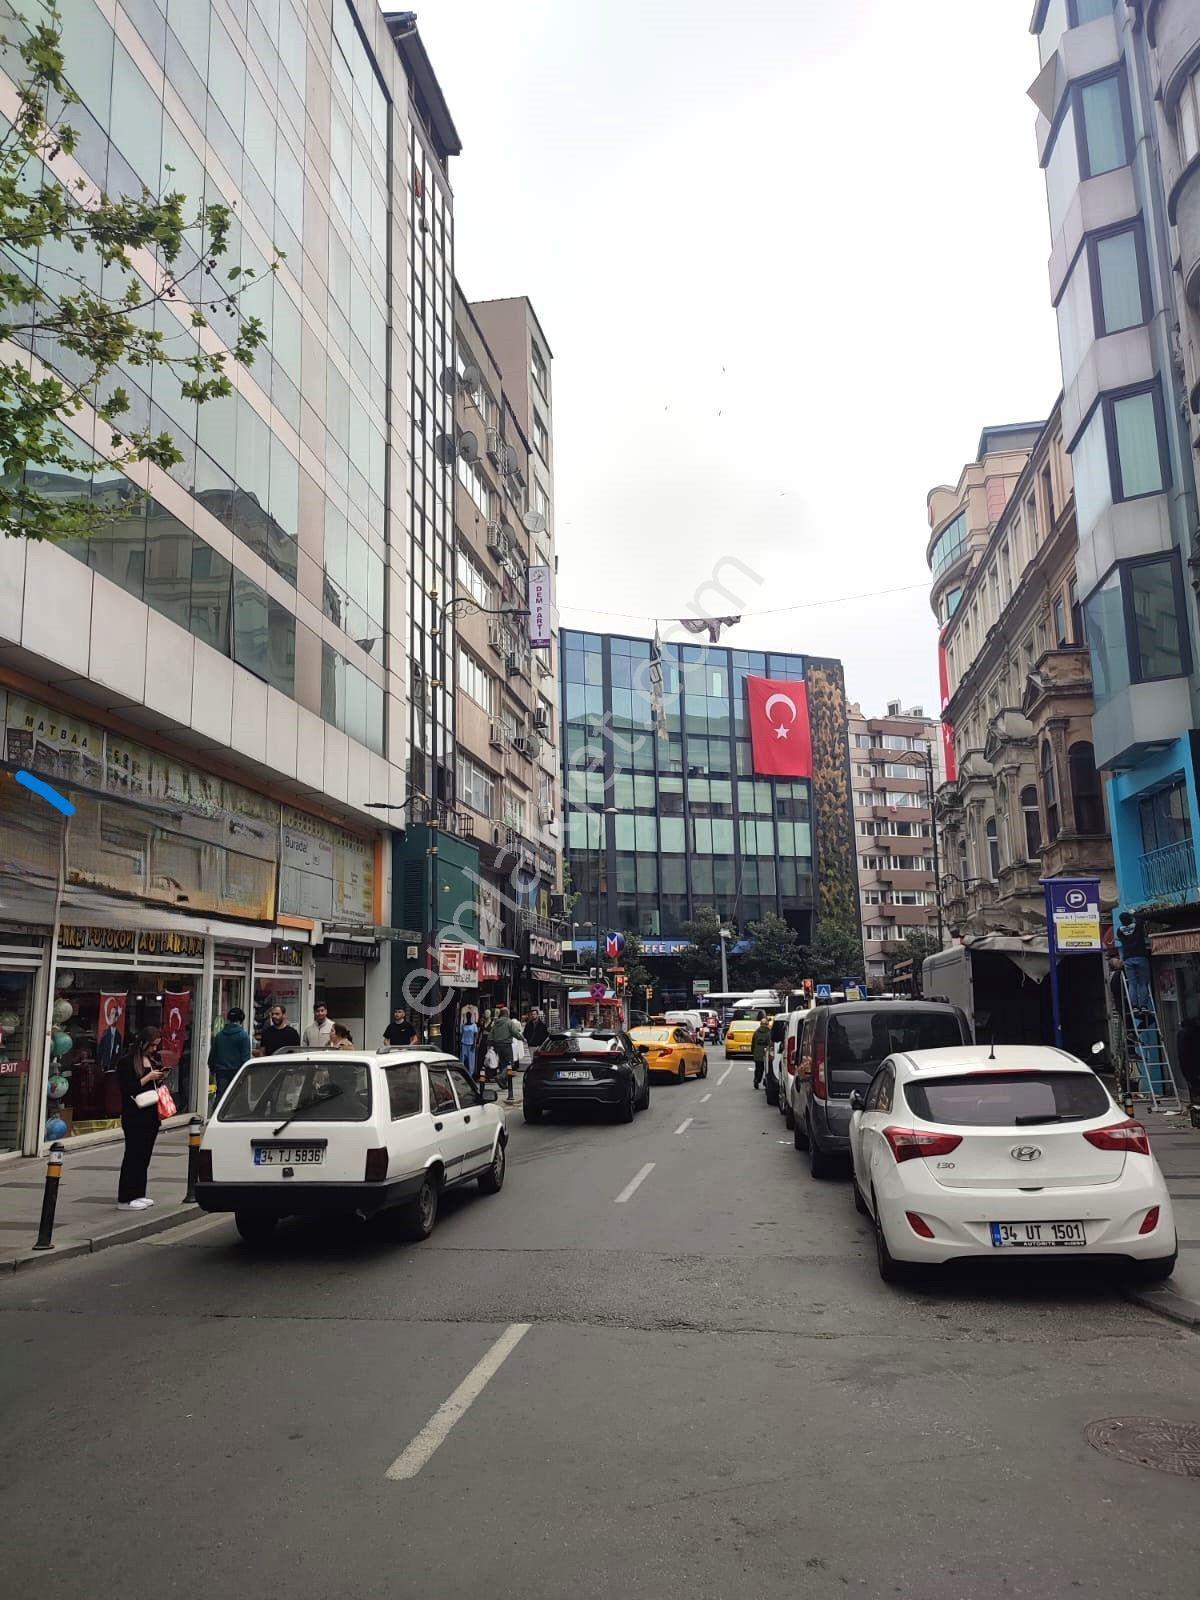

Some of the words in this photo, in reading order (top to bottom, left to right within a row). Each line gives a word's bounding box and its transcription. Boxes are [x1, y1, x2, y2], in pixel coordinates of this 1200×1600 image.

[535, 586, 543, 604] DEM
[25, 715, 88, 748] MATBAA
[606, 936, 618, 953] M
[0, 1062, 18, 1073] EXIT
[261, 1150, 273, 1163] 34
[279, 1149, 292, 1163] TJ
[295, 1149, 322, 1162] 5836
[1001, 1225, 1018, 1241] 34
[1025, 1224, 1041, 1240] UT
[1050, 1223, 1081, 1240] 1501
